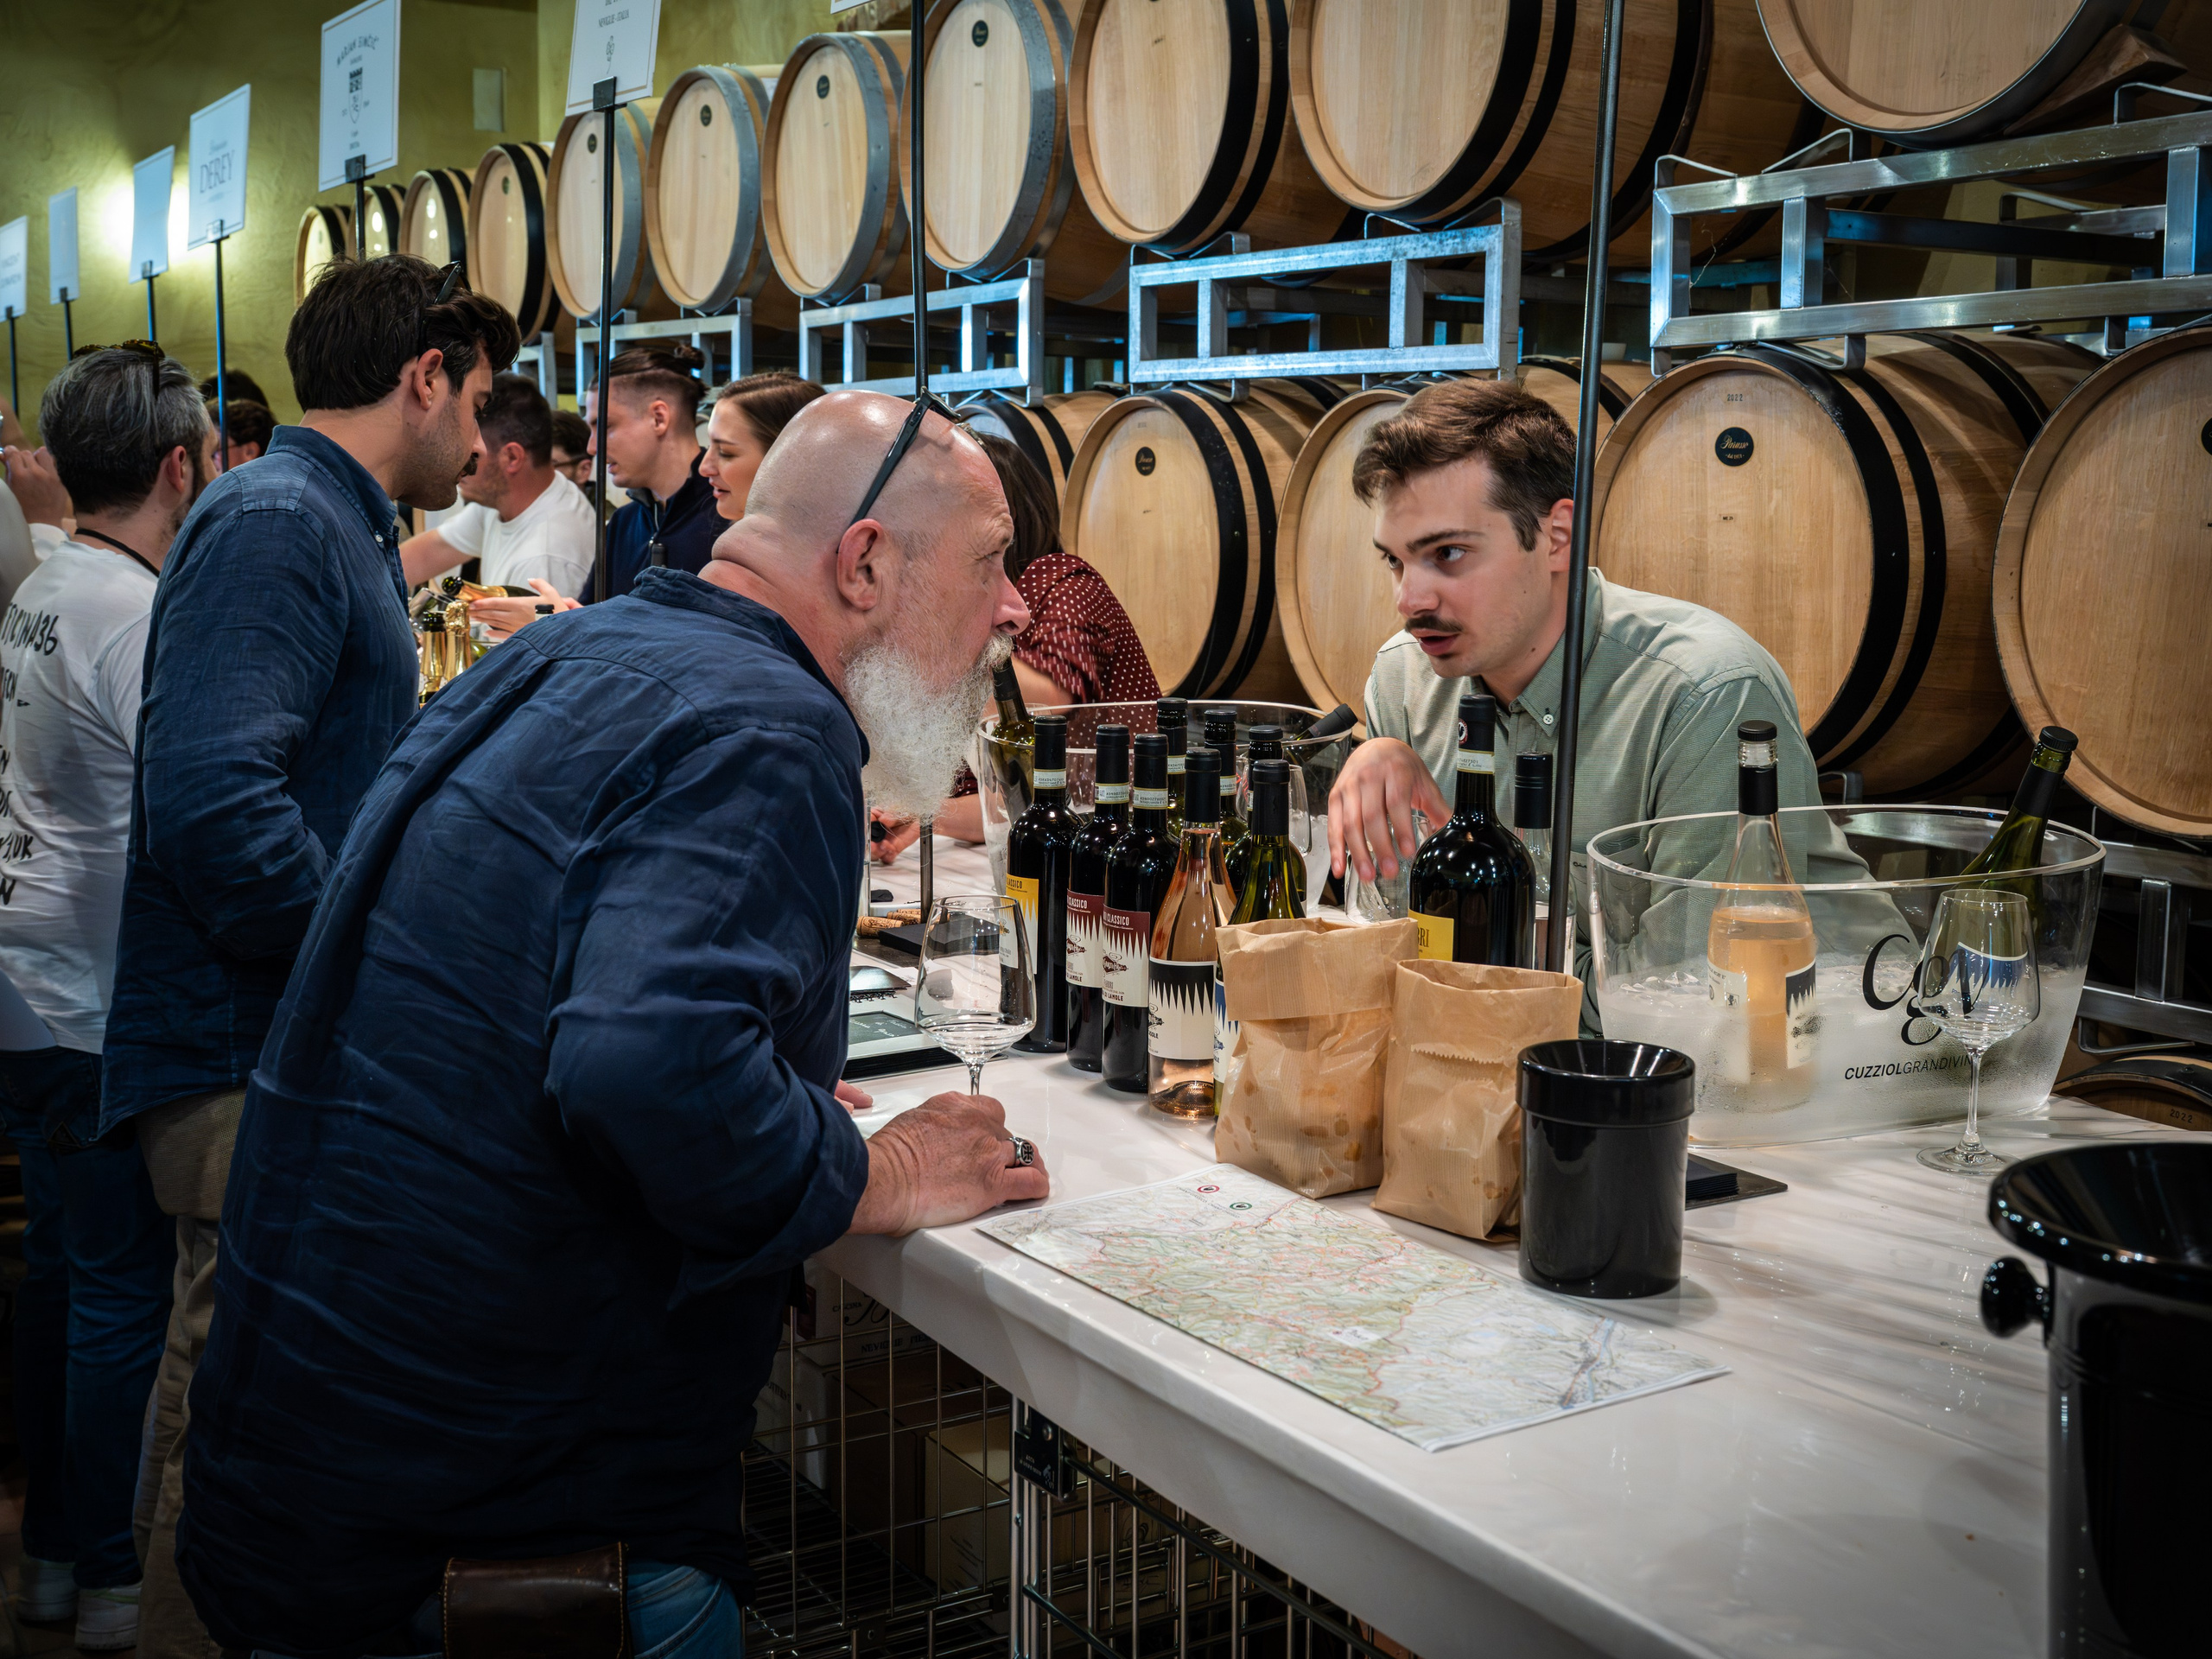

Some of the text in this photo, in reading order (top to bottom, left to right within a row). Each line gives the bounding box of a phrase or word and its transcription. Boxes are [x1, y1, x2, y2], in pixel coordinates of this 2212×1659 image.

[200, 149, 236, 194] DEREY
[1107, 912, 1130, 926] CLASSICO
[1108, 993, 1124, 1001] LAMOLE
[1844, 1053, 1974, 1081] CUZZIOLGRANDIVIN
[2170, 1108, 2193, 1124] 2022
[861, 1338, 903, 1354] NEVIGIE
